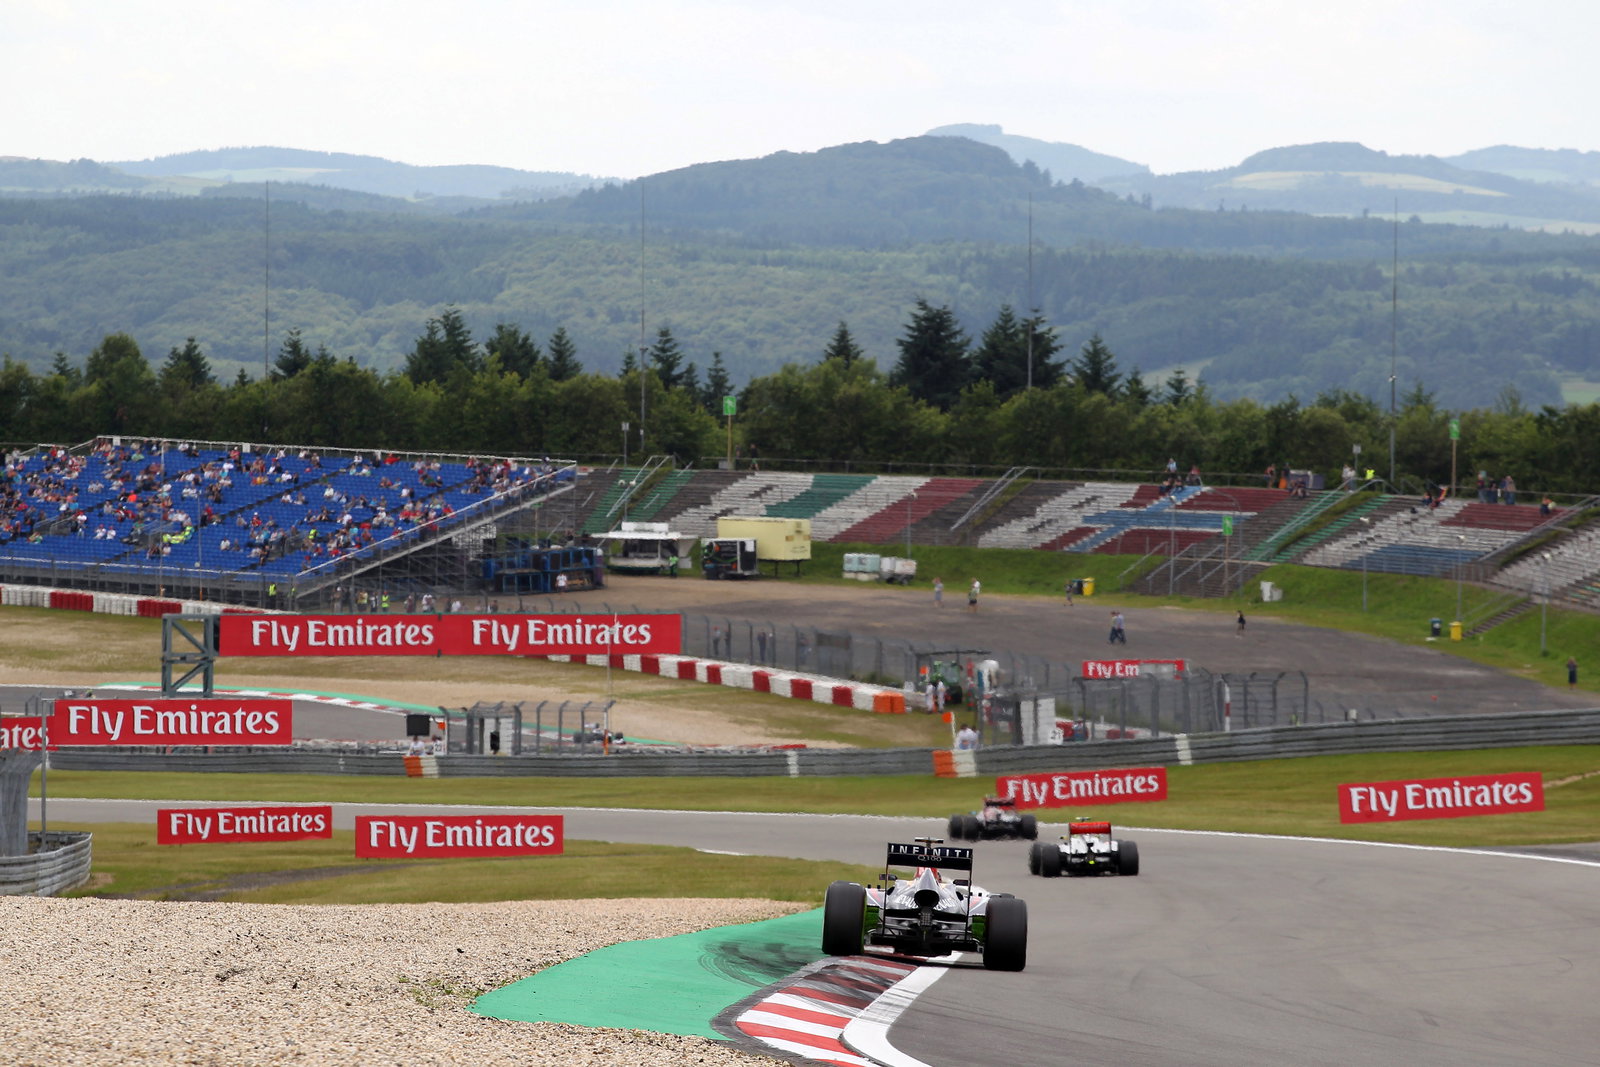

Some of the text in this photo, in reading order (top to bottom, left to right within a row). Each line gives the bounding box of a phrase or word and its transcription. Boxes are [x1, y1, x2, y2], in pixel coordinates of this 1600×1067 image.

[251, 618, 434, 651] Fly Emirates
[472, 618, 651, 651] Fly Emirates
[1087, 661, 1113, 678] Fly
[68, 704, 280, 741] Fly Emirates
[1006, 773, 1159, 805] Fly Emirates
[1349, 780, 1534, 817] Fly Emirates
[170, 810, 326, 840] Fly Emirates
[369, 819, 555, 853] Fly Emirates
[890, 844, 970, 858] INFINITI
